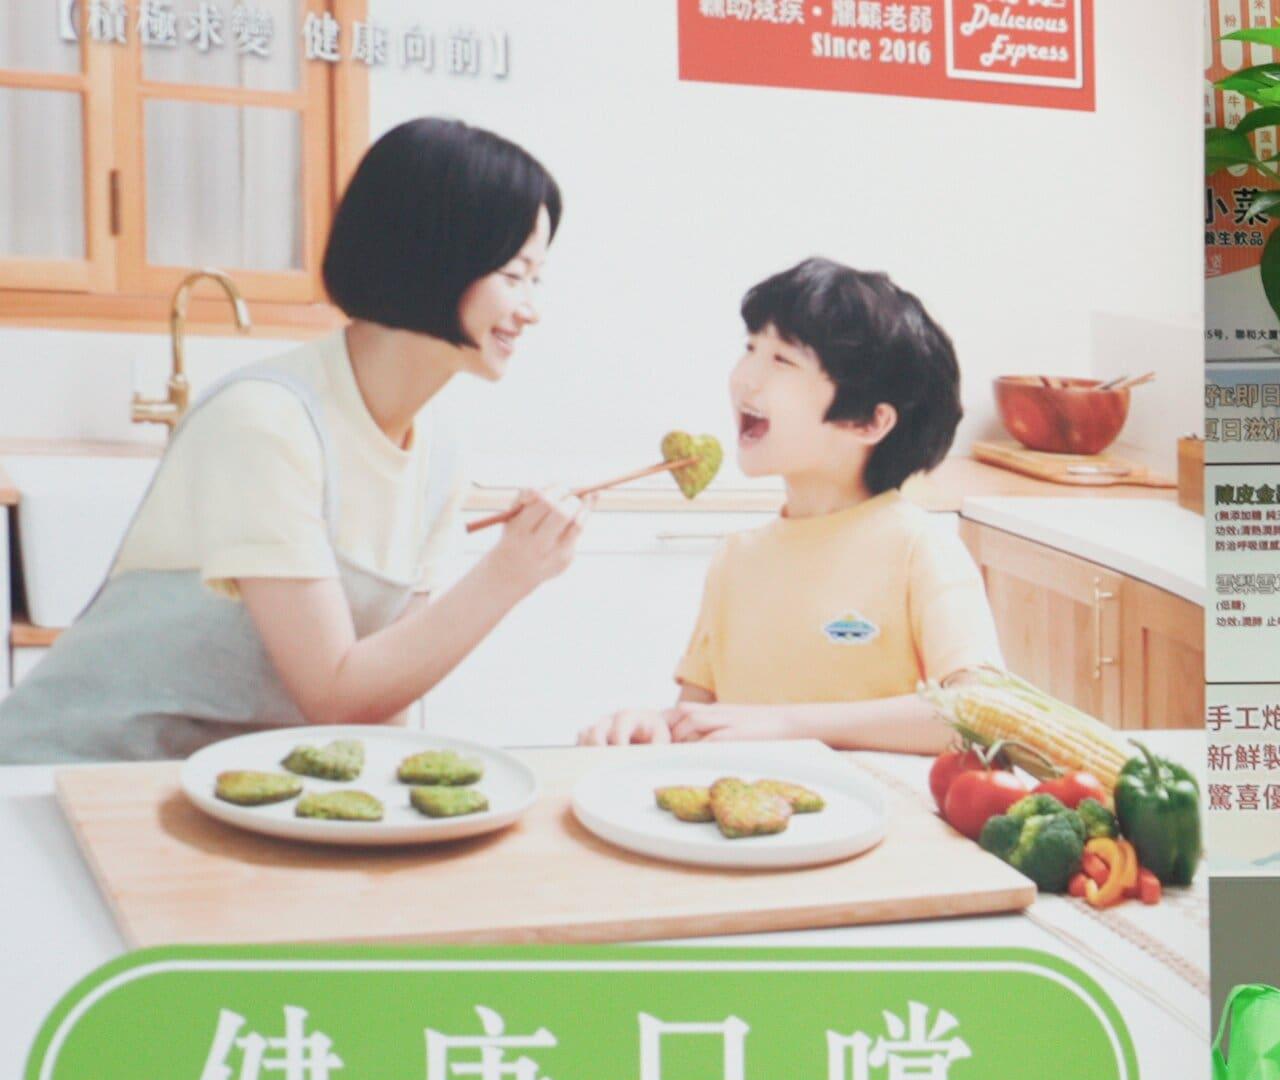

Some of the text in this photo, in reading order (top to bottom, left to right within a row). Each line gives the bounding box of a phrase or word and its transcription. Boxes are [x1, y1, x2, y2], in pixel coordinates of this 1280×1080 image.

[960, 5, 1069, 36] Delicious
[811, 32, 931, 65] Since 2016
[979, 35, 1069, 67] Express
